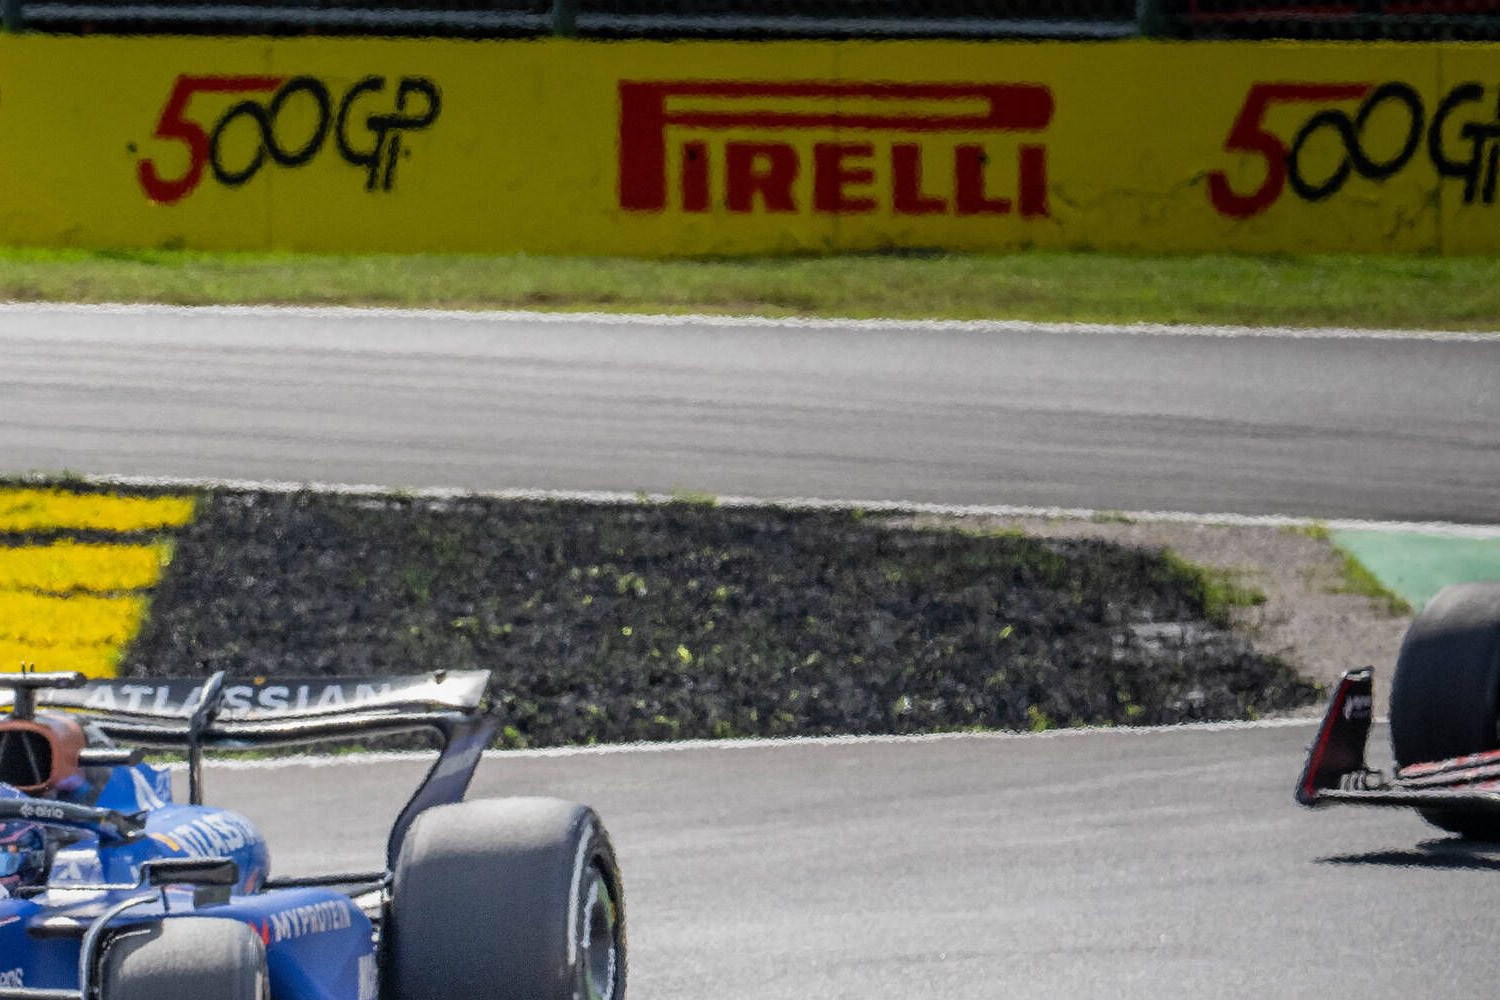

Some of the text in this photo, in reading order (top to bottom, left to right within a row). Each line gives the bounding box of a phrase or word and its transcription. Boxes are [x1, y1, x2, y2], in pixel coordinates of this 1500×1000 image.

[137, 75, 442, 205] 500GP
[617, 80, 1055, 219] PIRELLI
[1207, 81, 1500, 219] 500G
